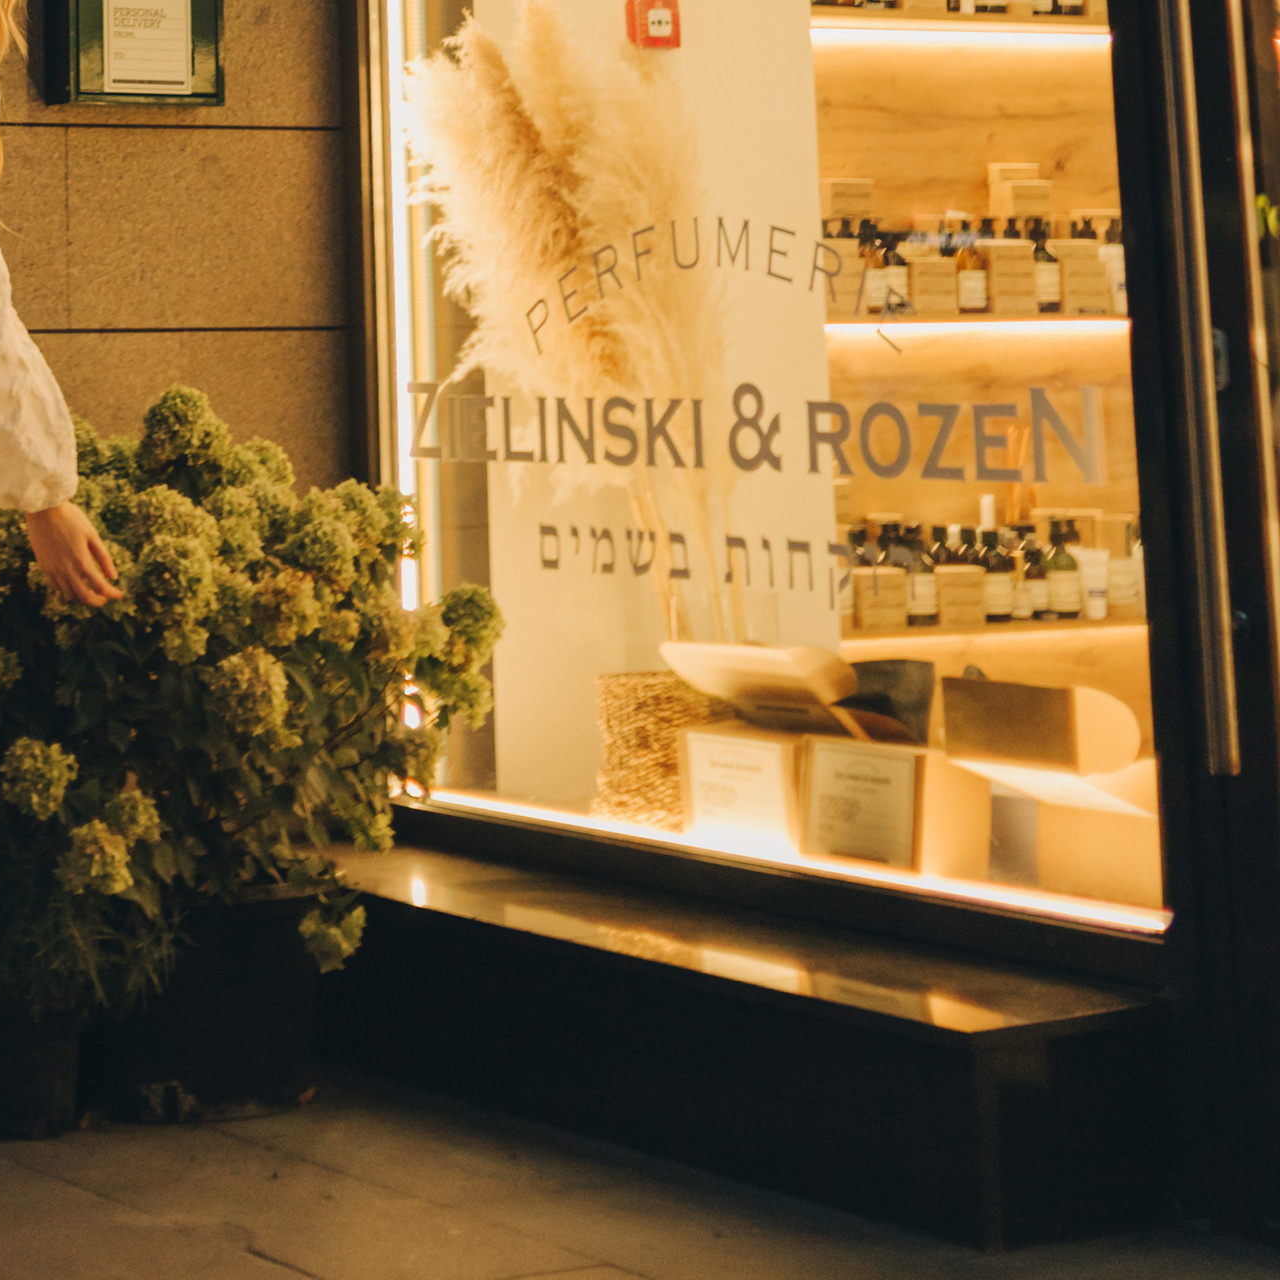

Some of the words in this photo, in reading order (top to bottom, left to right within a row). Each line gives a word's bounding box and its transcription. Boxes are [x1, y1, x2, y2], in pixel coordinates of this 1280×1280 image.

[113, 7, 167, 18] PERSONAL
[113, 17, 162, 28] DELIVERY
[407, 381, 705, 469] ZIELINSKI
[728, 382, 782, 472] &
[806, 385, 1109, 485] ROZEN
[539, 521, 691, 581] בשמים
